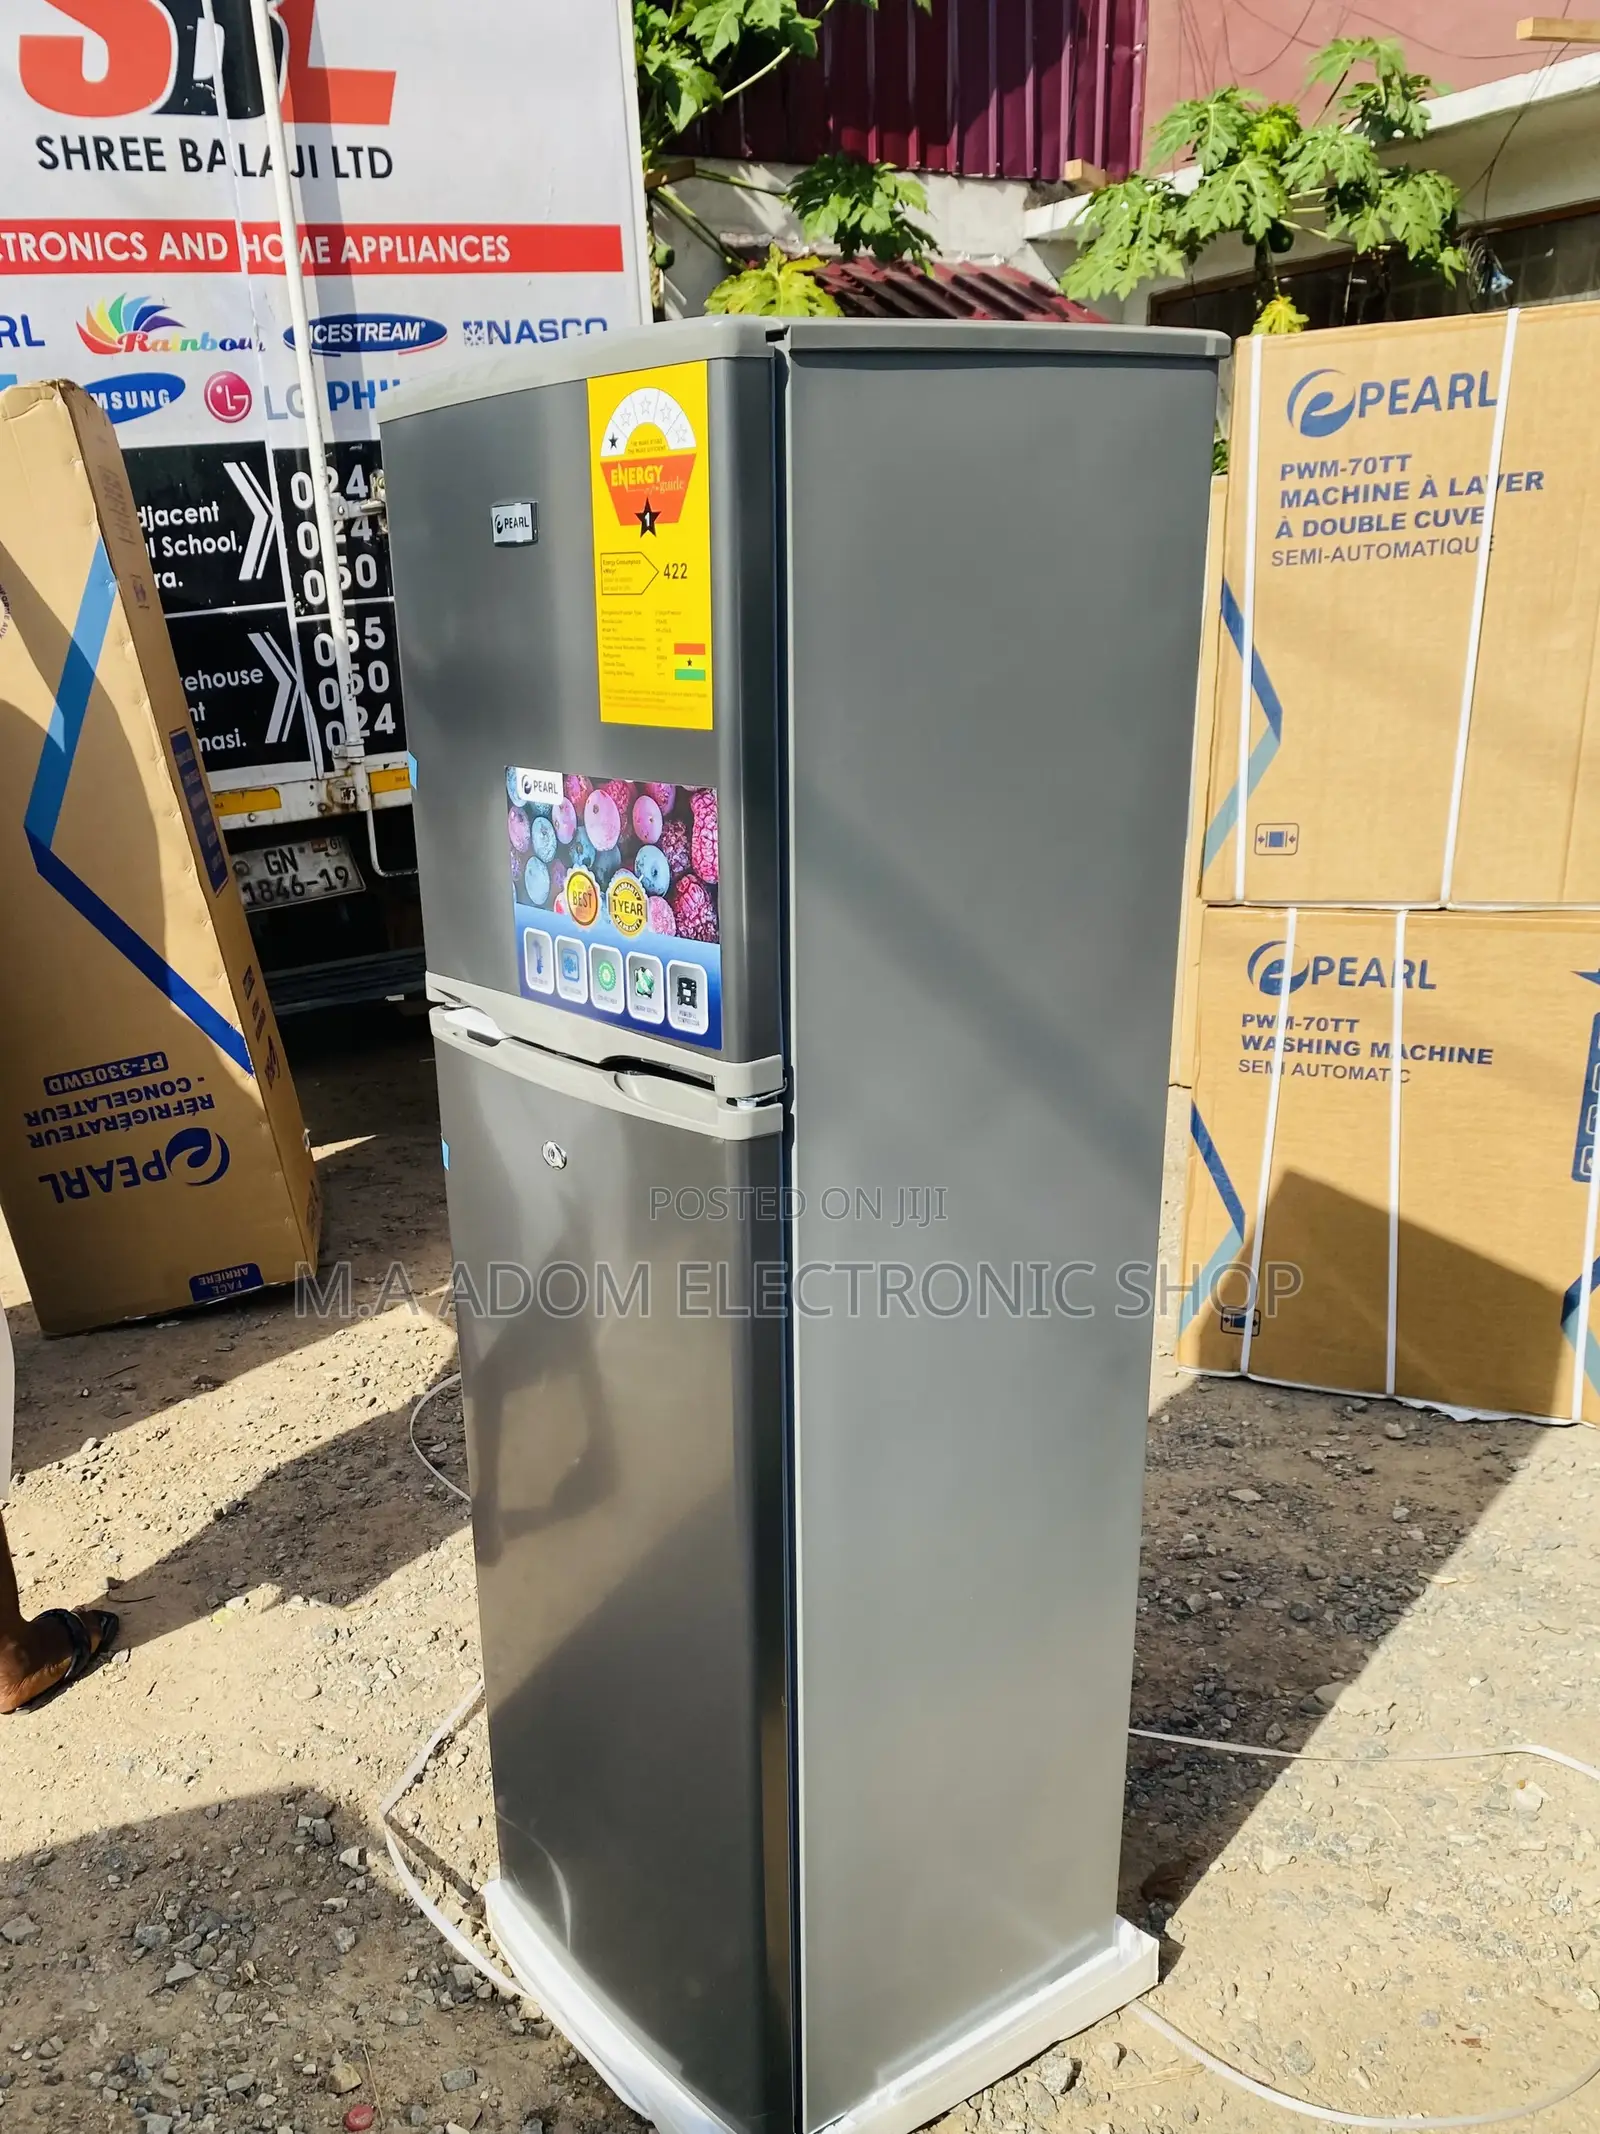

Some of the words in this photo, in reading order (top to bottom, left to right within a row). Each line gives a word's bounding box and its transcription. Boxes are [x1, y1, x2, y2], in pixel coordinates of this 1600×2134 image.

[35, 134, 166, 172] SHREE
[332, 145, 393, 179] LTD
[159, 231, 228, 262] AND
[340, 235, 511, 264] APPLIANCES
[309, 322, 422, 344] ICESTREAM
[90, 386, 170, 411] MSUNG
[1357, 370, 1498, 419] PEARL
[611, 463, 664, 491] ENERGY
[1280, 453, 1413, 481] PWM-70TT
[1280, 481, 1410, 509] MACHINE
[1418, 474, 1439, 499] À
[137, 501, 220, 532] djacent
[504, 516, 530, 529] PEARL
[644, 511, 651, 528] 1
[1275, 515, 1294, 539] À
[1302, 512, 1407, 538] DOUBLE
[1413, 505, 1485, 530] CUVE
[162, 530, 243, 557] School,
[1271, 534, 1495, 567] SEMI-AUTOMATIQU
[663, 562, 688, 580] 422
[183, 668, 264, 692] ehouse
[533, 775, 559, 795] PEARL
[263, 847, 299, 876] GN
[242, 865, 350, 906] 1846-19
[572, 890, 593, 909] BEST
[612, 899, 617, 912] 1
[618, 899, 644, 917] YEAR
[1311, 955, 1437, 990] PEARL
[1241, 1034, 1361, 1057] WASHING
[48, 1053, 165, 1094] PF-330BWD
[1291, 1062, 1411, 1083] AUTOMATC
[23, 1075, 193, 1128] CONGELATEUR
[26, 1092, 216, 1149] RÉFRIGÉRATEUR
[38, 1148, 167, 1204] PEARL
[211, 1280, 243, 1295] FACE
